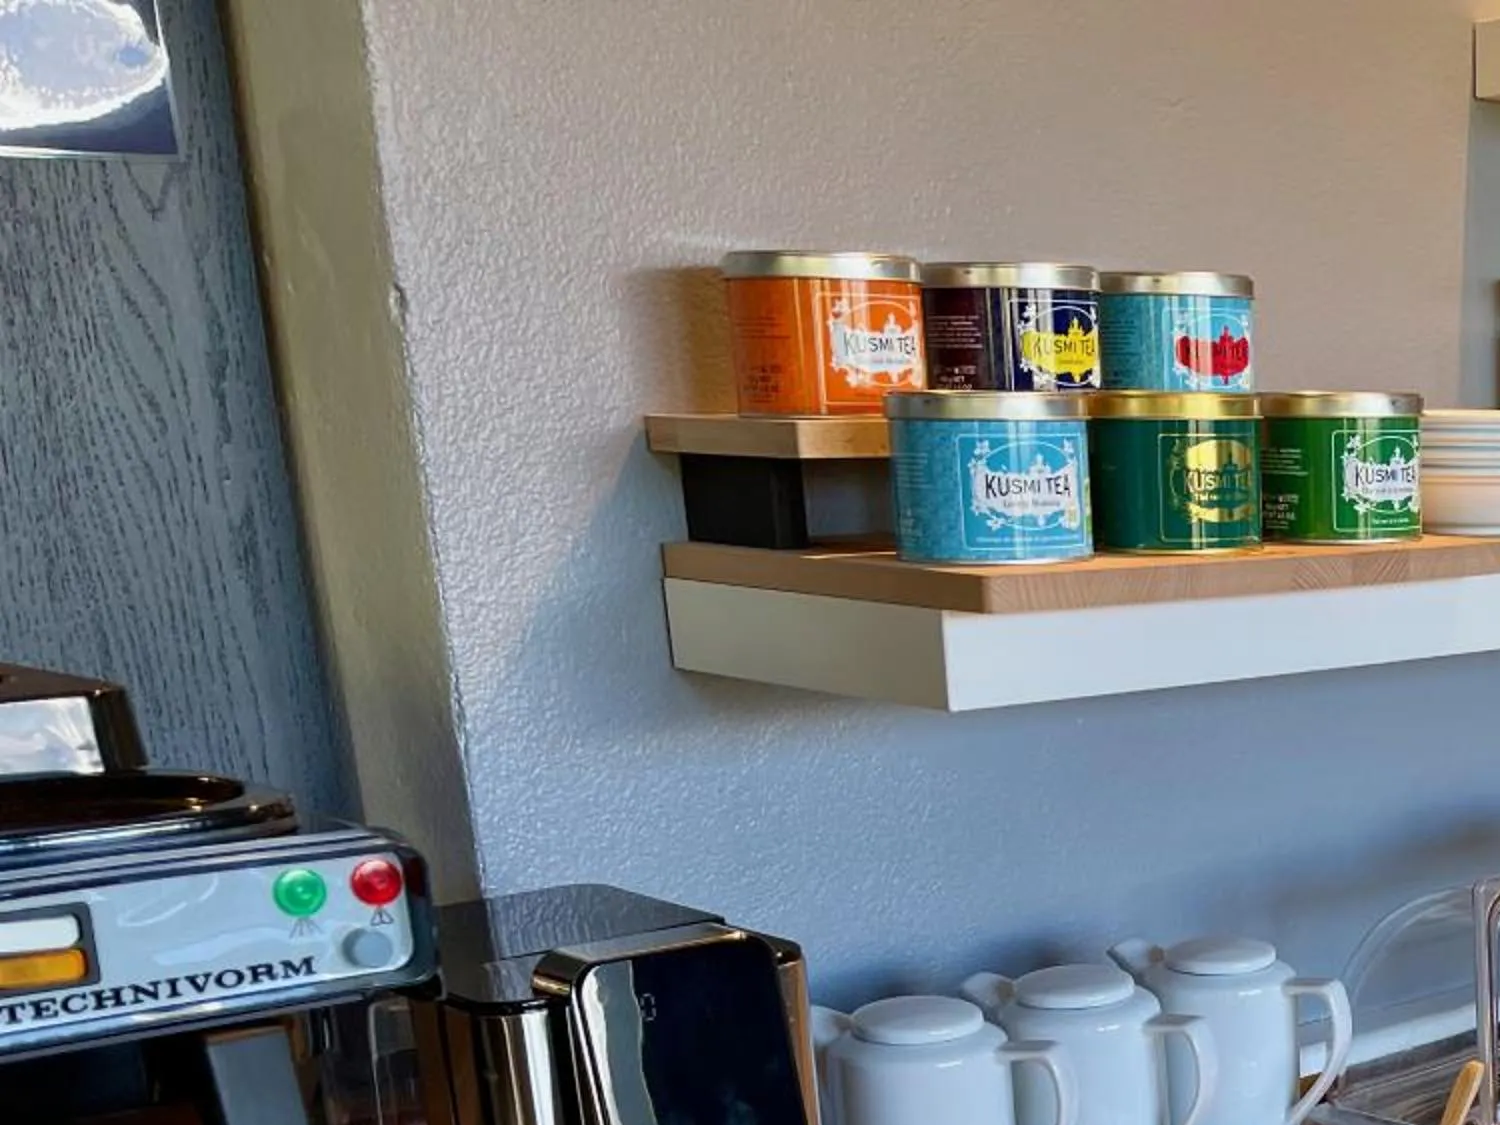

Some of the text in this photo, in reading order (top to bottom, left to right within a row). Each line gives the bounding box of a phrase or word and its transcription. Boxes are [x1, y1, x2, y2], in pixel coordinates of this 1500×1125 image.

[843, 331, 916, 357] KUSMI TEA
[1033, 337, 1077, 358] KUSMI
[1080, 338, 1095, 356] TEA
[985, 473, 1072, 499] KUSMI TEA
[1184, 469, 1231, 493] KUSMI
[1354, 464, 1417, 488] KUSMI TEA
[0, 956, 318, 1026] TECHNIVORM
